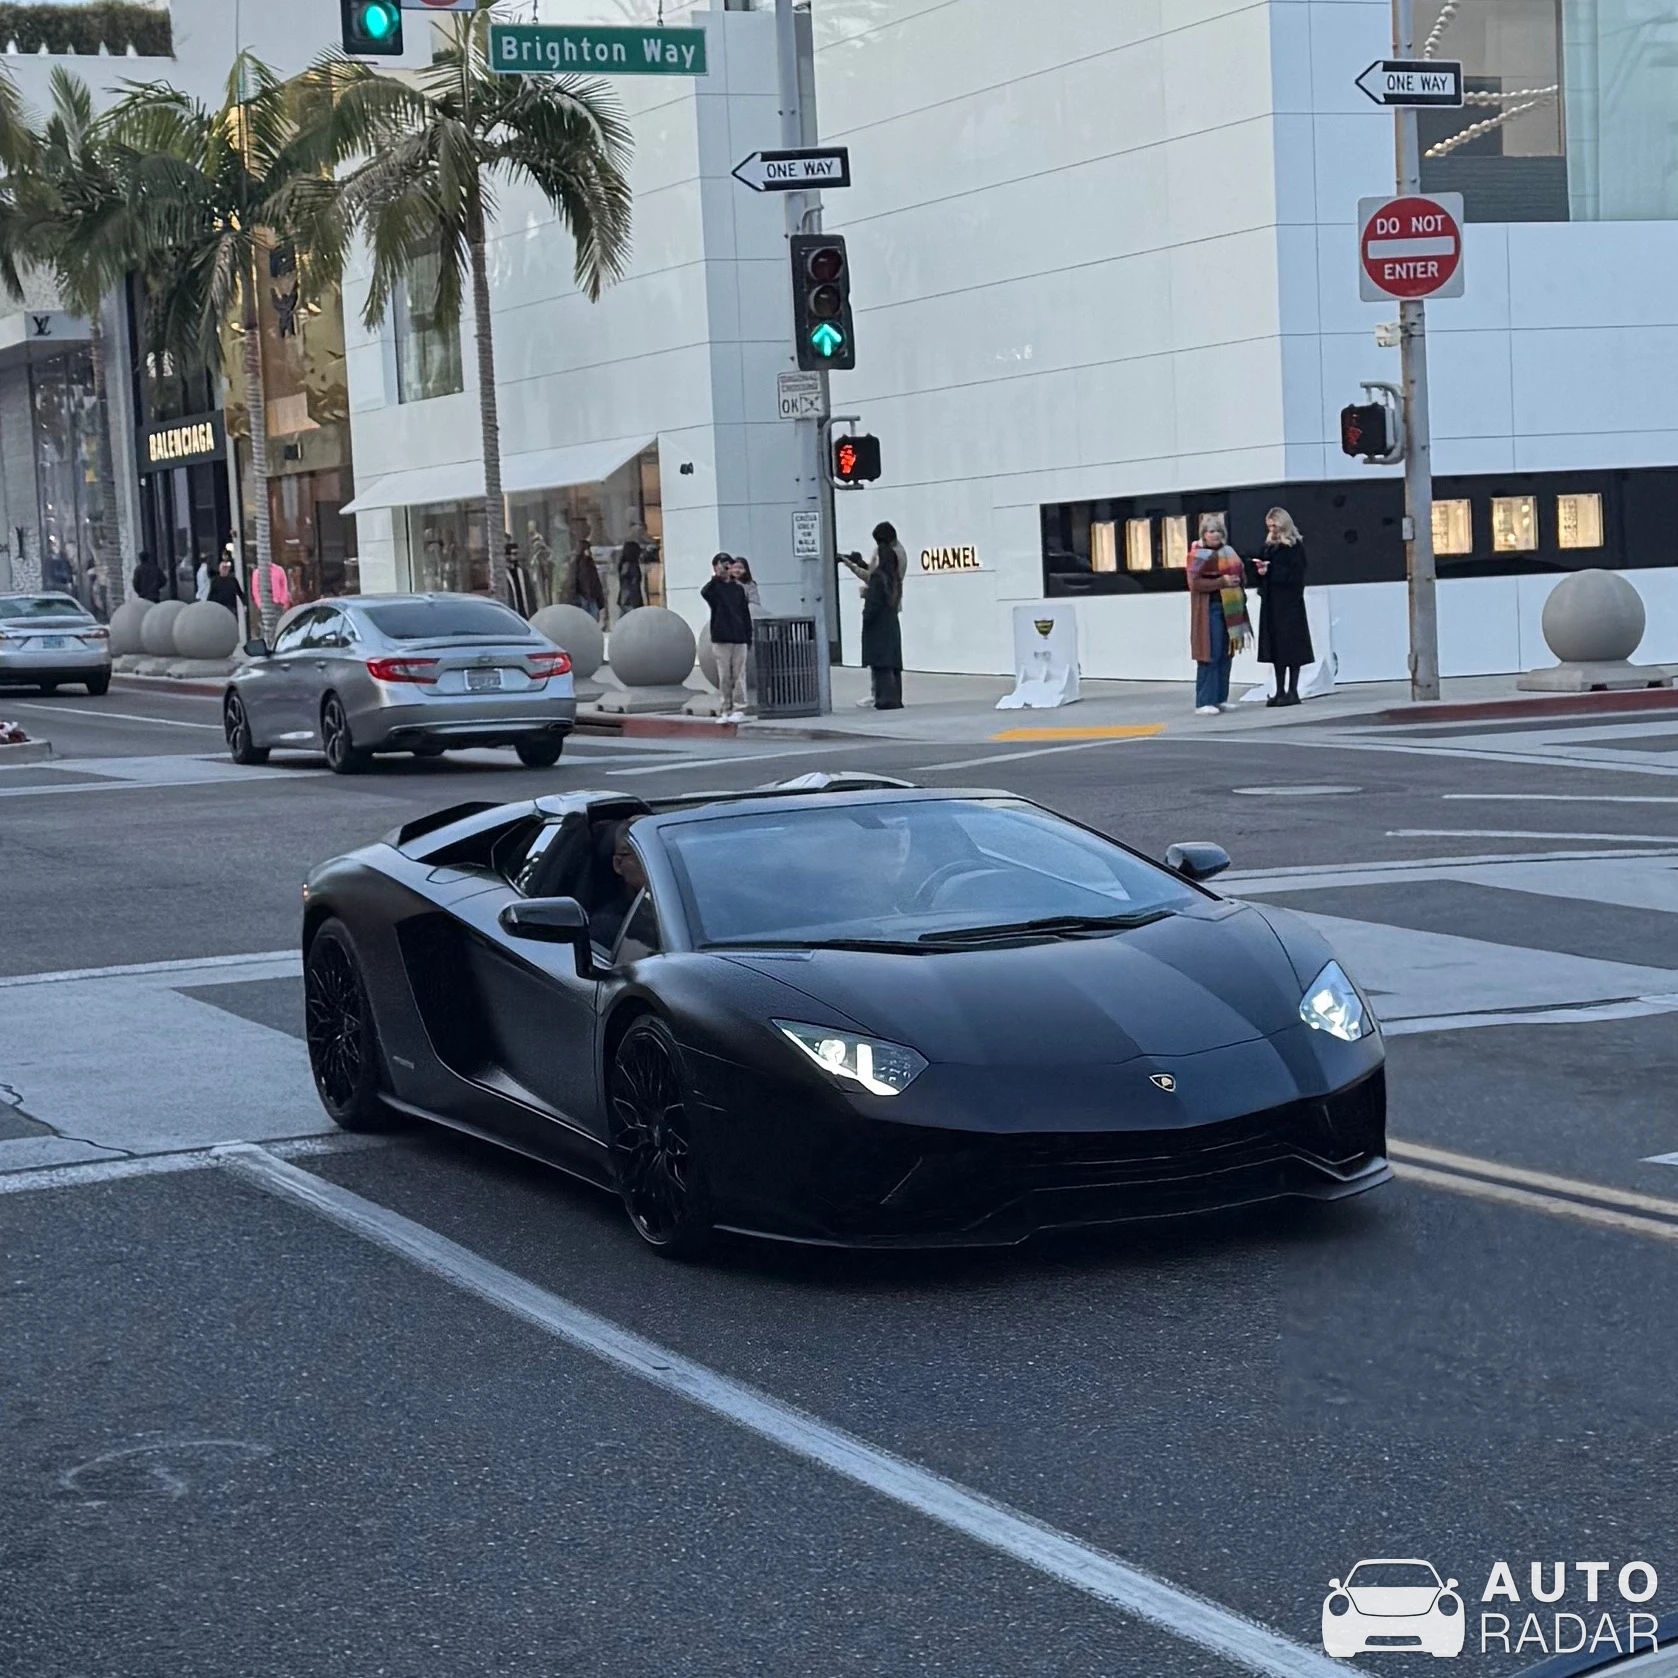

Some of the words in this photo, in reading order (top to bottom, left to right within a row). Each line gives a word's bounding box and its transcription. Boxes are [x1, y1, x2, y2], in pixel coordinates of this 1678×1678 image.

[501, 36, 626, 68] Brighton
[642, 38, 695, 69] Way
[1387, 74, 1414, 91] ONE
[1420, 75, 1447, 92] WAY
[766, 162, 797, 178] ONE
[803, 160, 833, 176] WAY
[1376, 217, 1399, 235] DO
[1411, 214, 1446, 233] NOT
[1384, 261, 1439, 280] ENTER
[782, 398, 799, 413] OK
[149, 422, 214, 461] BALENCIAGA
[920, 545, 980, 571] CHANEL
